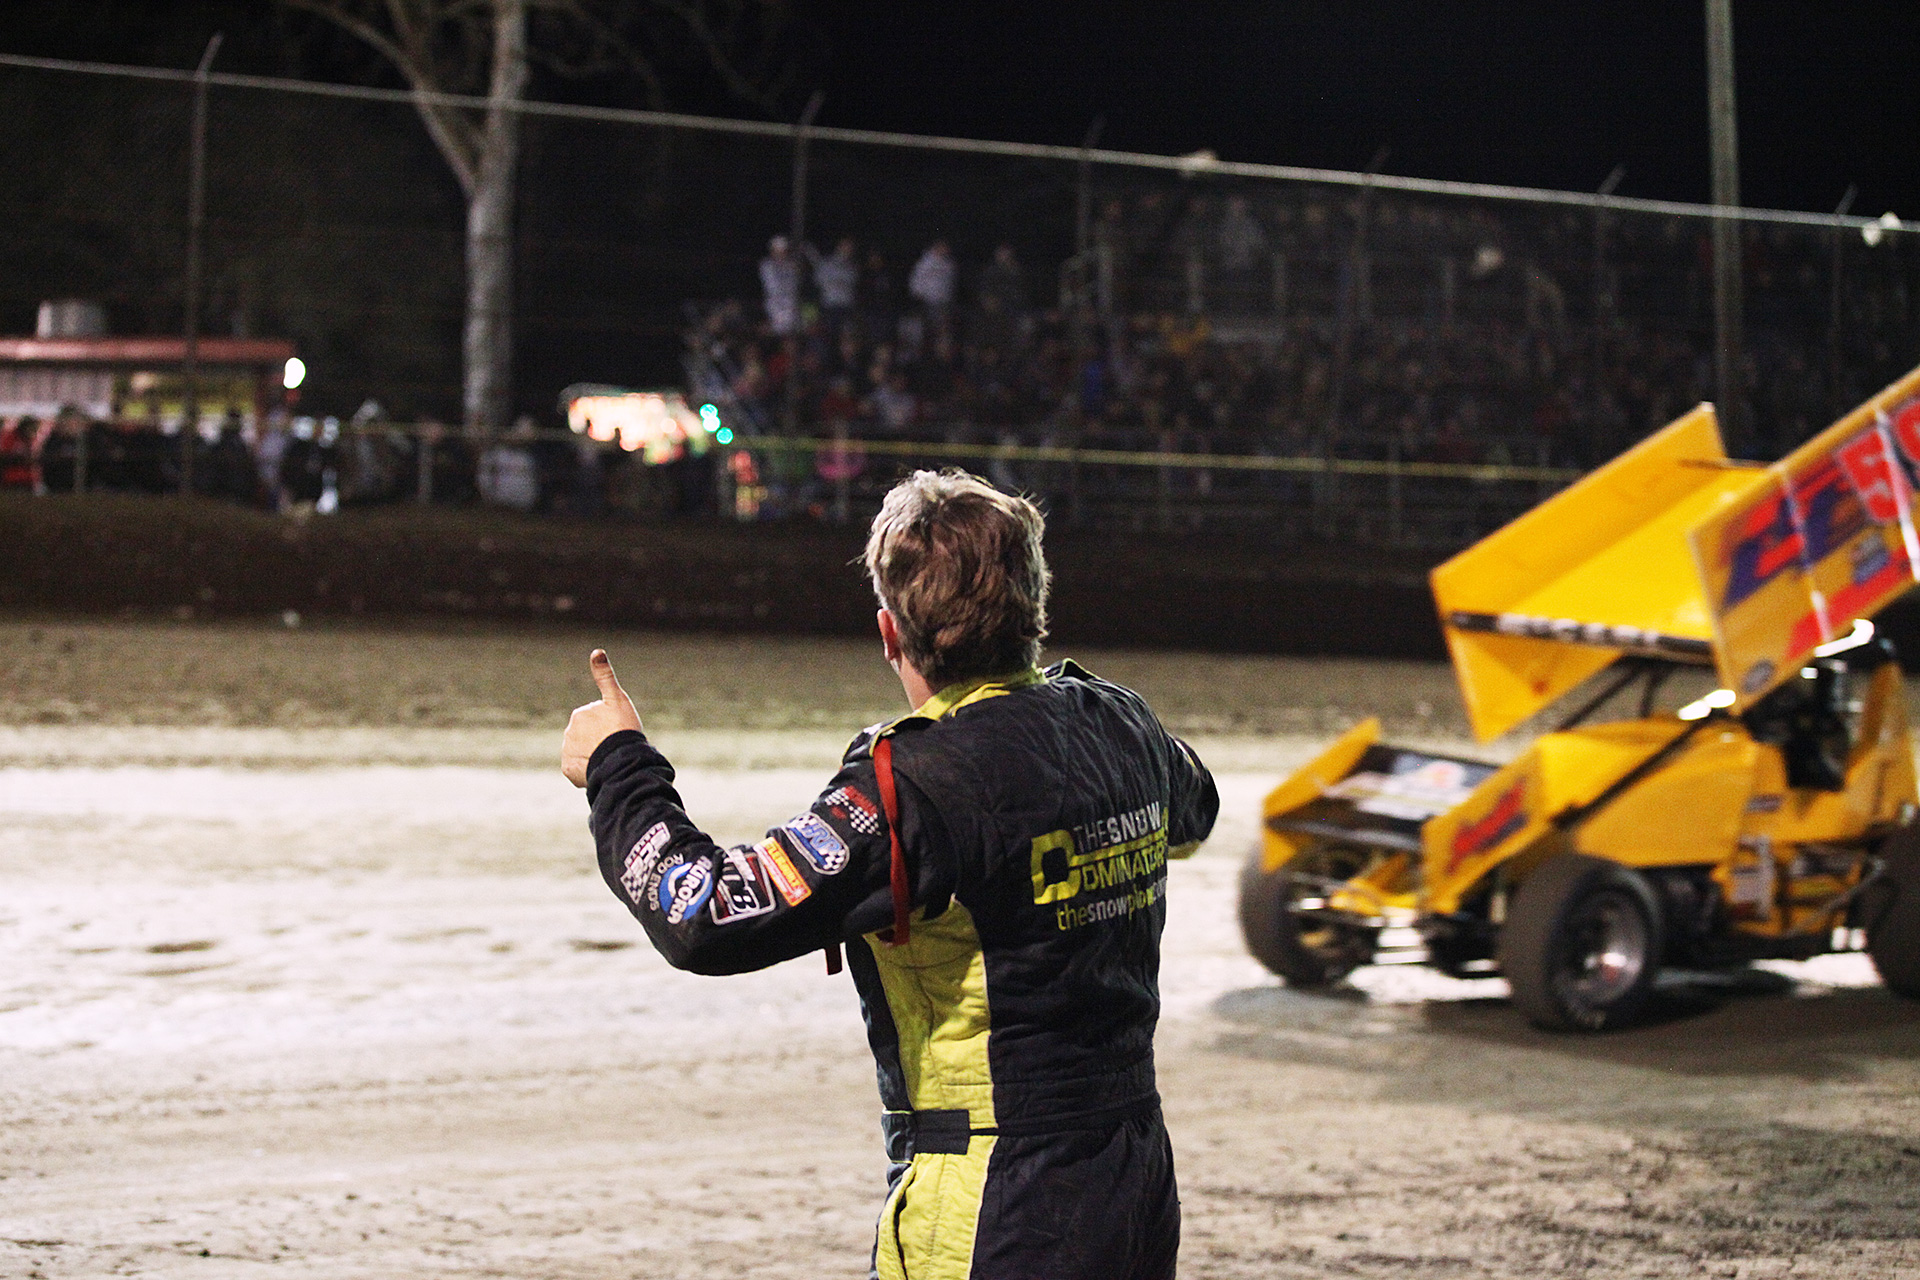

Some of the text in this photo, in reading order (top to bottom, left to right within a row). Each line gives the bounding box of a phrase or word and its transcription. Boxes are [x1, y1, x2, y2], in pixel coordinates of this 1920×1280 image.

[657, 852, 684, 875] ROD
[647, 874, 662, 912] ENDS
[667, 855, 713, 925] AURORA
